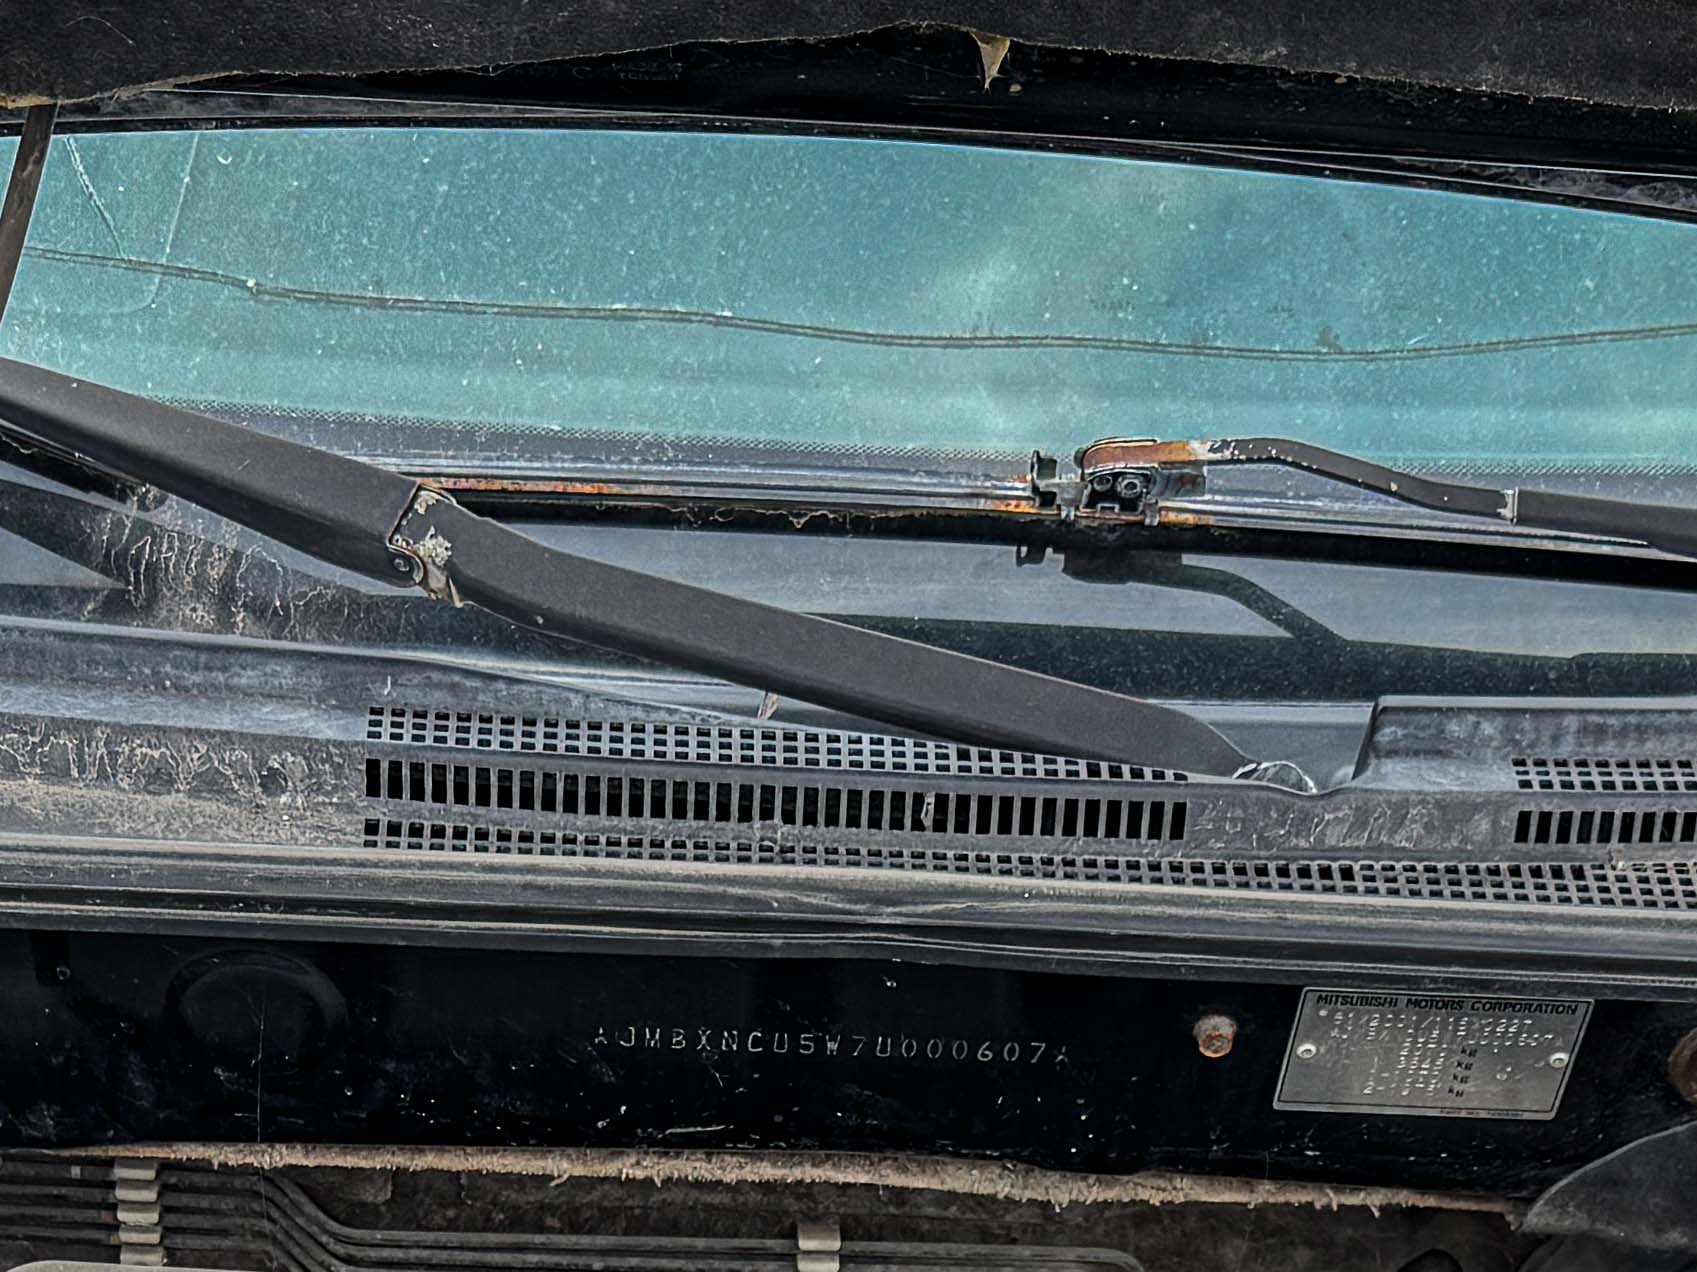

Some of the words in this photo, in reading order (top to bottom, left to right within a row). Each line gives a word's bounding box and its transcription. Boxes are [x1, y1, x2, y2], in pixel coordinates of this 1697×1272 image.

[1316, 993, 1399, 1008] MITSUBISHI
[1405, 998, 1465, 1012] MOTORS
[1470, 1000, 1579, 1016] CORPORATION
